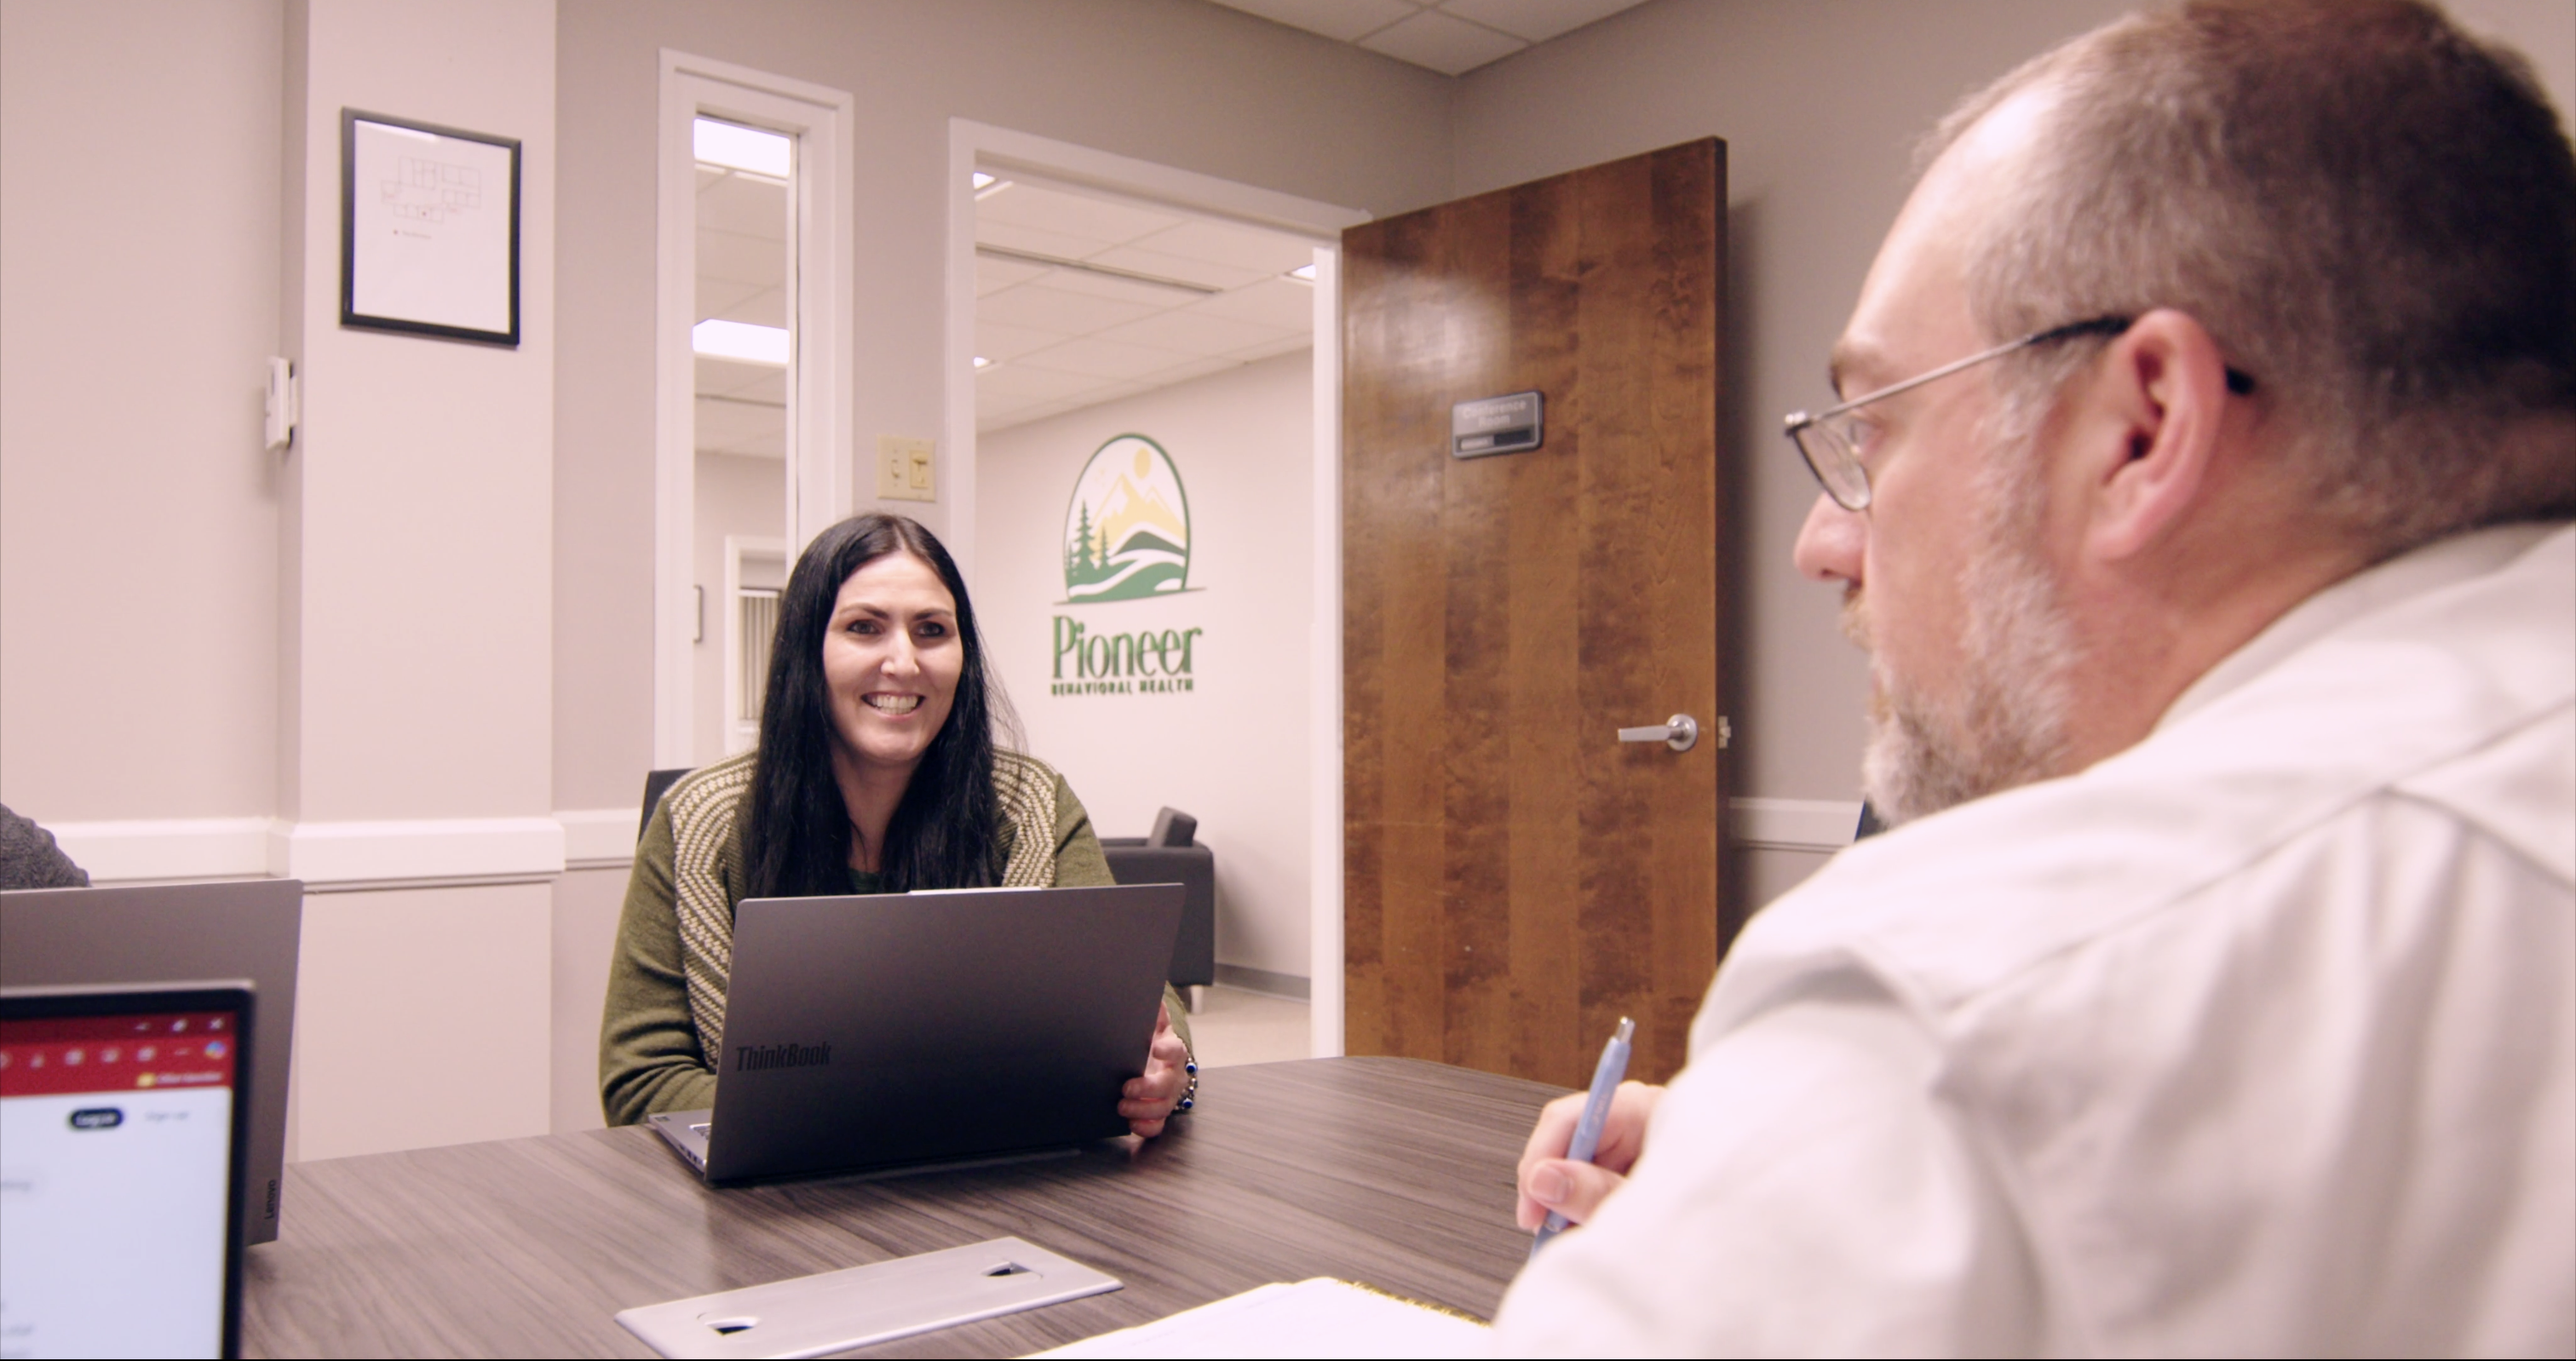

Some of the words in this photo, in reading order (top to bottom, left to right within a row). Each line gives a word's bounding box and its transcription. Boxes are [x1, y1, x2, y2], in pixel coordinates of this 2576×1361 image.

[1053, 615, 1203, 679] Pioneer
[1051, 682, 1132, 696] BEHAVIORAL
[1139, 679, 1193, 693] HEALTH
[736, 1041, 831, 1071] ThinkBook
[263, 1179, 277, 1220] Lenovo
